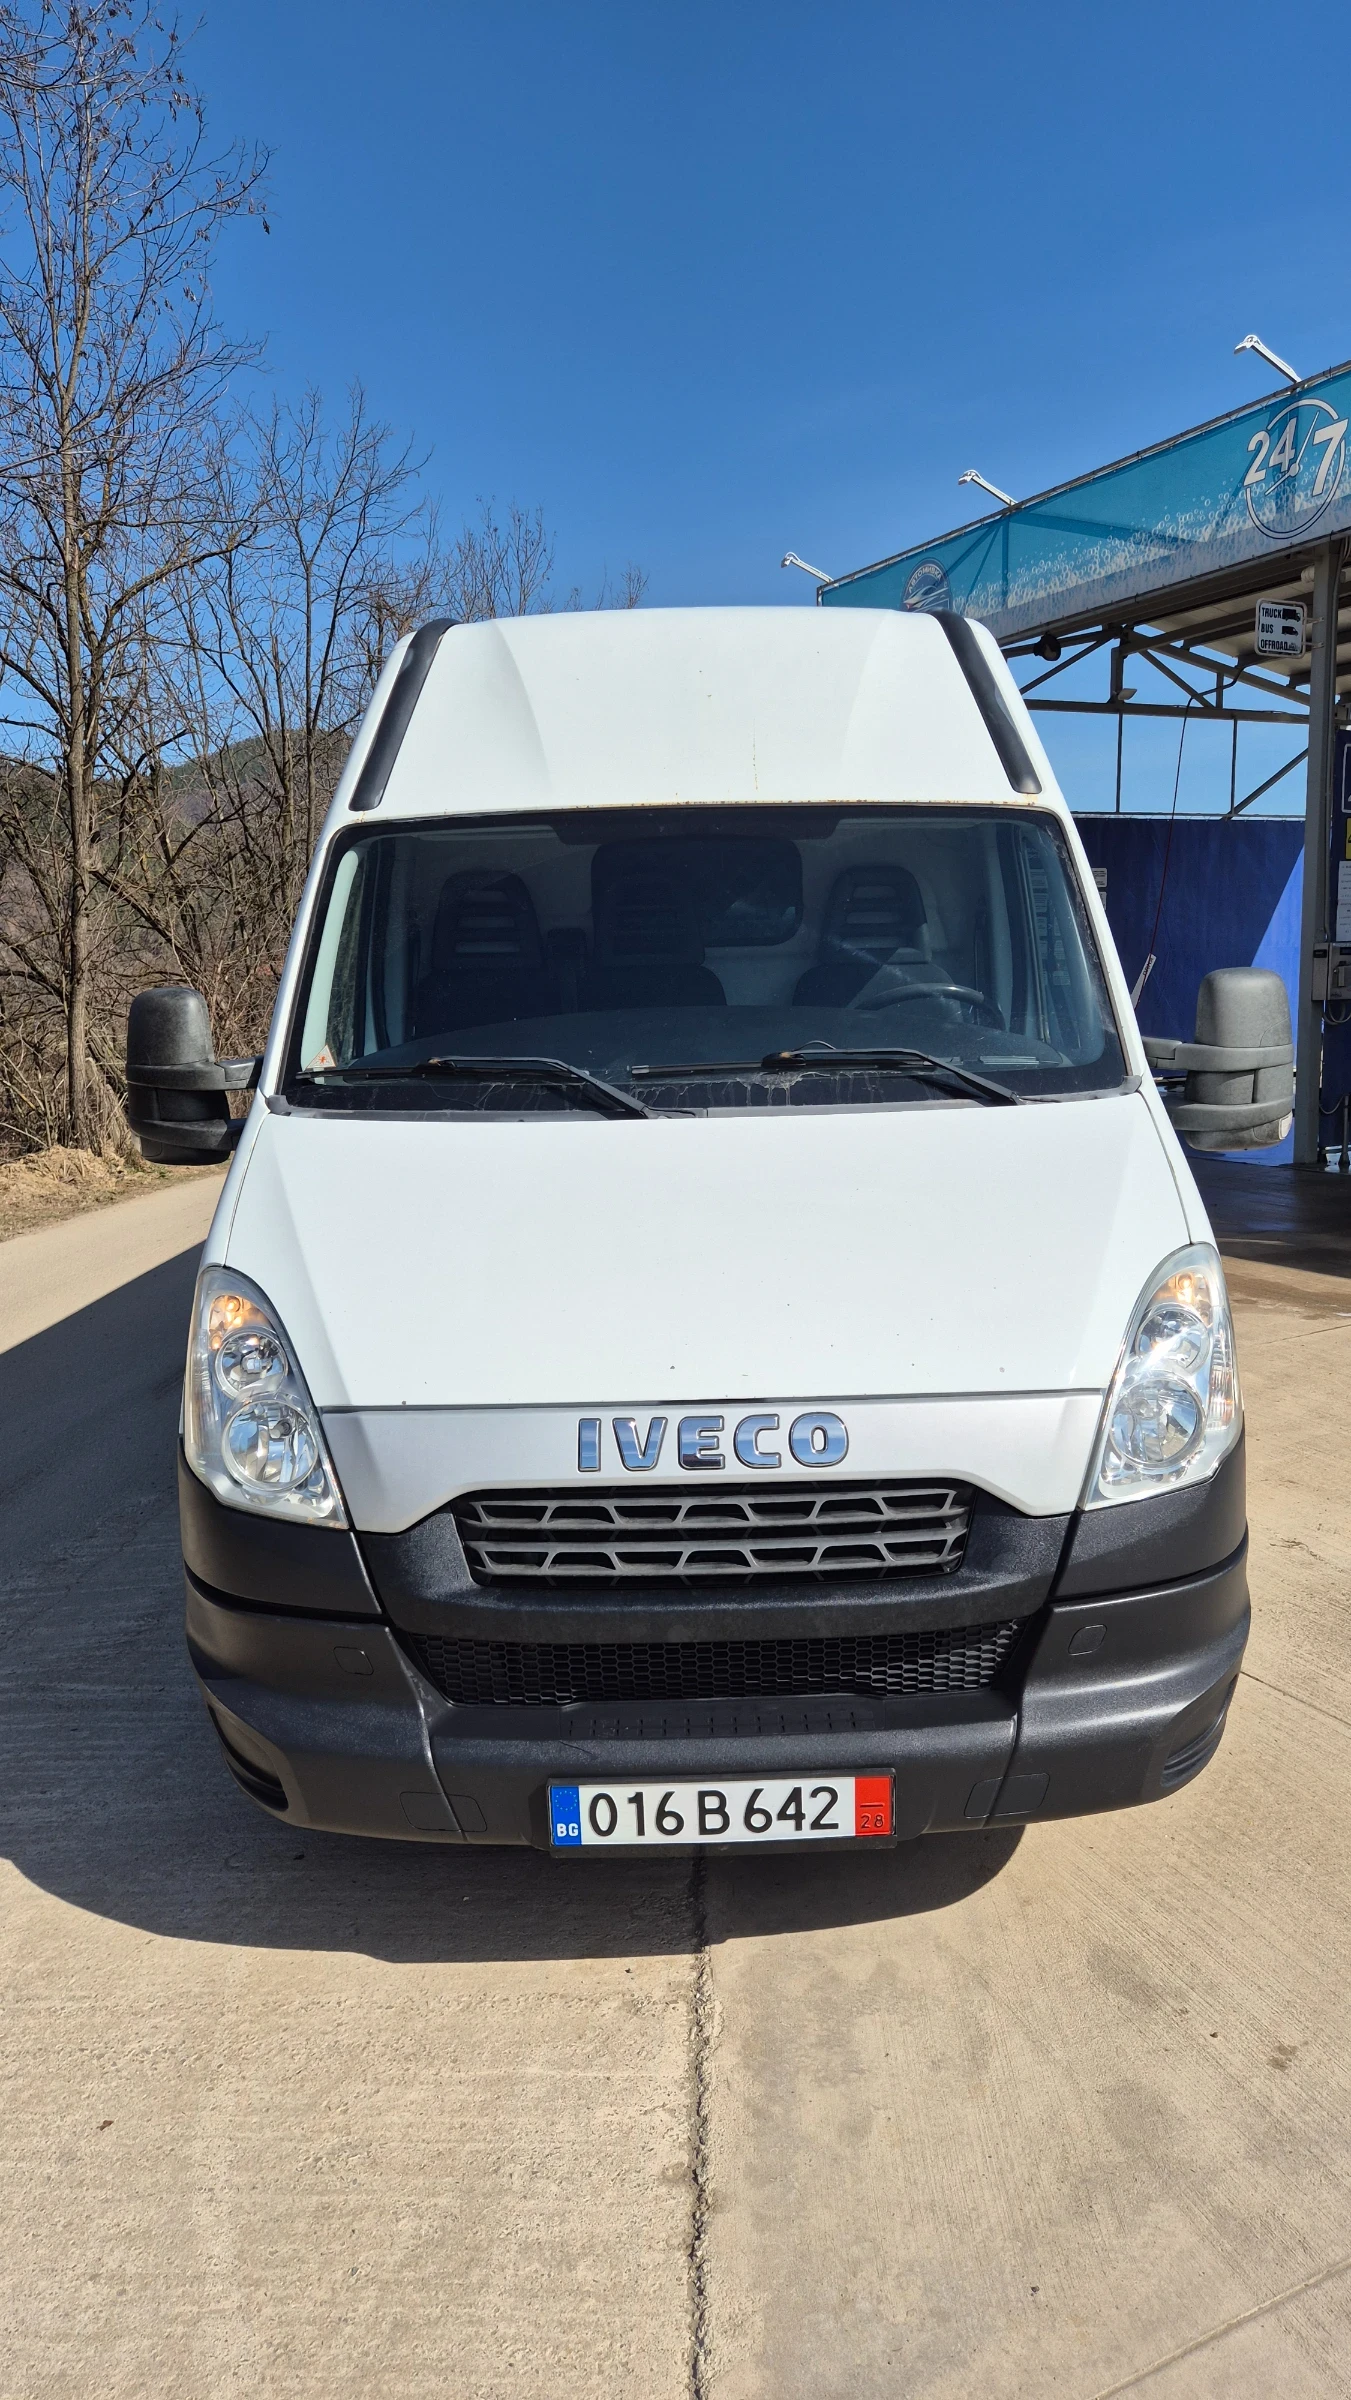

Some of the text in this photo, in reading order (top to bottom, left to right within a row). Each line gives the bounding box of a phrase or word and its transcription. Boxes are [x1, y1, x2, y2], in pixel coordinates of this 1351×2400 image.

[1261, 607, 1282, 619] TRUCK
[1260, 623, 1274, 634] BUS
[1260, 639, 1288, 651] OFFROAD
[577, 1411, 850, 1472] IVECO
[588, 1786, 839, 1837] 016 B 642
[860, 1814, 885, 1829] 28
[556, 1823, 579, 1837] BG
